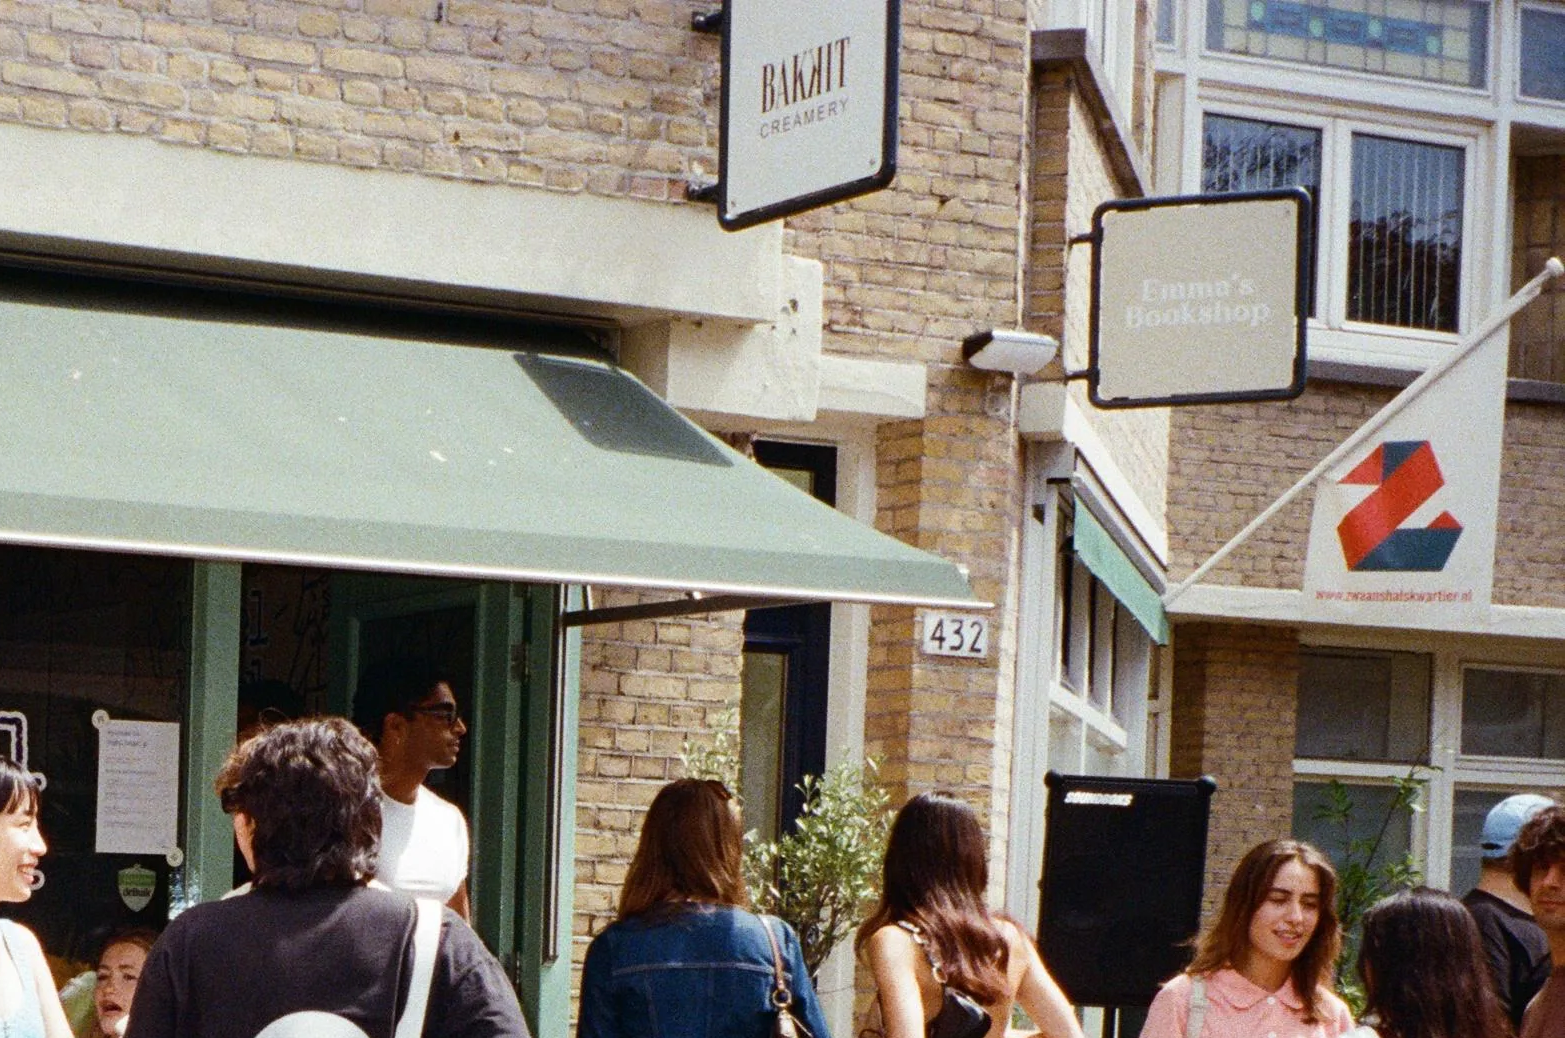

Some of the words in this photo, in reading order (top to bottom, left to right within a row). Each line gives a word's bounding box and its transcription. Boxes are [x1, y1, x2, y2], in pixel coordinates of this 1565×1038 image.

[760, 98, 850, 139] CREAMERY
[1141, 273, 1255, 302] Emma's
[1124, 301, 1272, 329] Bookshop
[930, 618, 983, 653] 432
